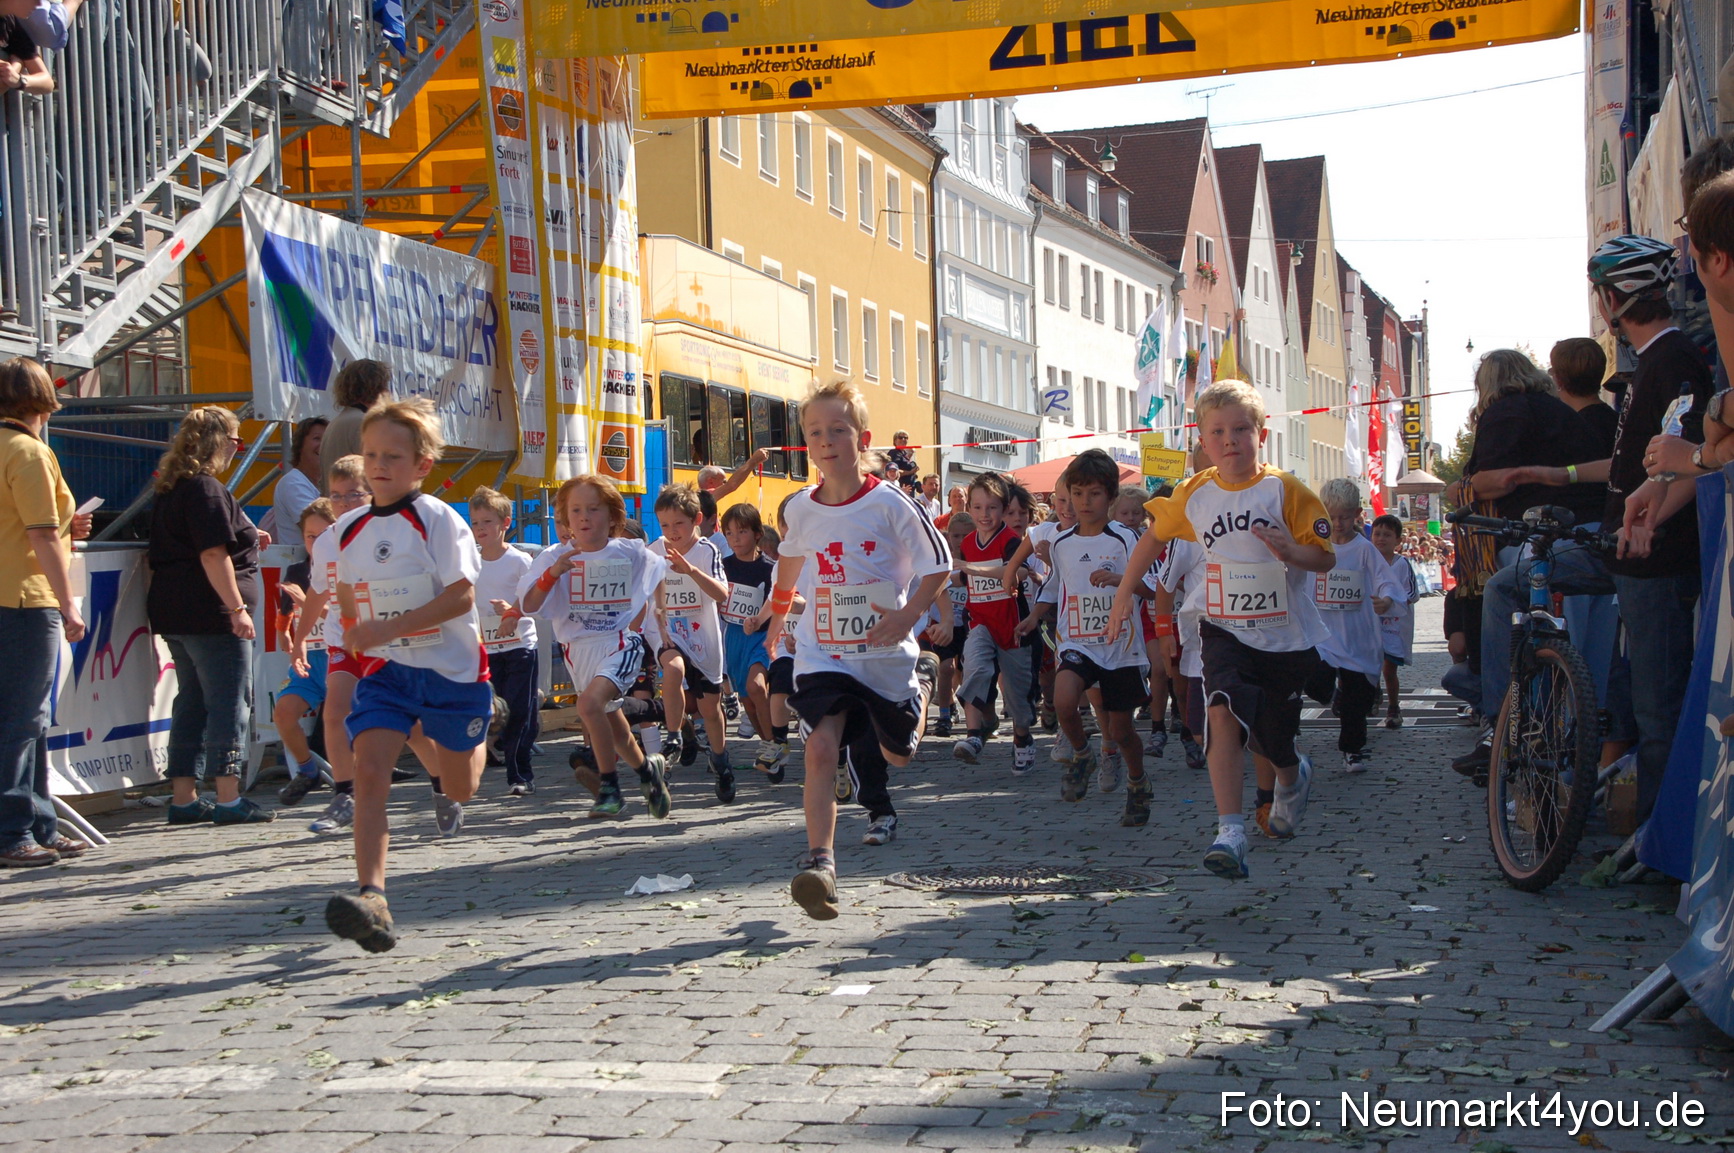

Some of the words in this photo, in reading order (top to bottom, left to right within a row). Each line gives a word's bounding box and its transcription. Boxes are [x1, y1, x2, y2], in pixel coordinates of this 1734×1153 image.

[1316, 1, 1429, 24] Neumarkter
[685, 59, 791, 77] Neumarkter
[796, 51, 876, 72] Stadtlauf
[326, 246, 499, 367] PFLEIDERER
[1405, 404, 1420, 469] HOTE
[665, 577, 683, 586] anuel
[974, 579, 1003, 591] 7294
[1328, 573, 1350, 582] Adrian
[588, 582, 626, 598] 7171
[949, 590, 966, 601] 716
[1329, 588, 1361, 600] 7094
[665, 592, 697, 605] 7158
[834, 592, 867, 606] Simon
[1083, 595, 1116, 613] PAU
[1228, 591, 1278, 611] 7221
[732, 601, 760, 616] 7090
[818, 613, 827, 624] K2
[837, 614, 883, 636] 704
[1083, 615, 1109, 631] 729
[69, 754, 134, 779] COMPUTER
